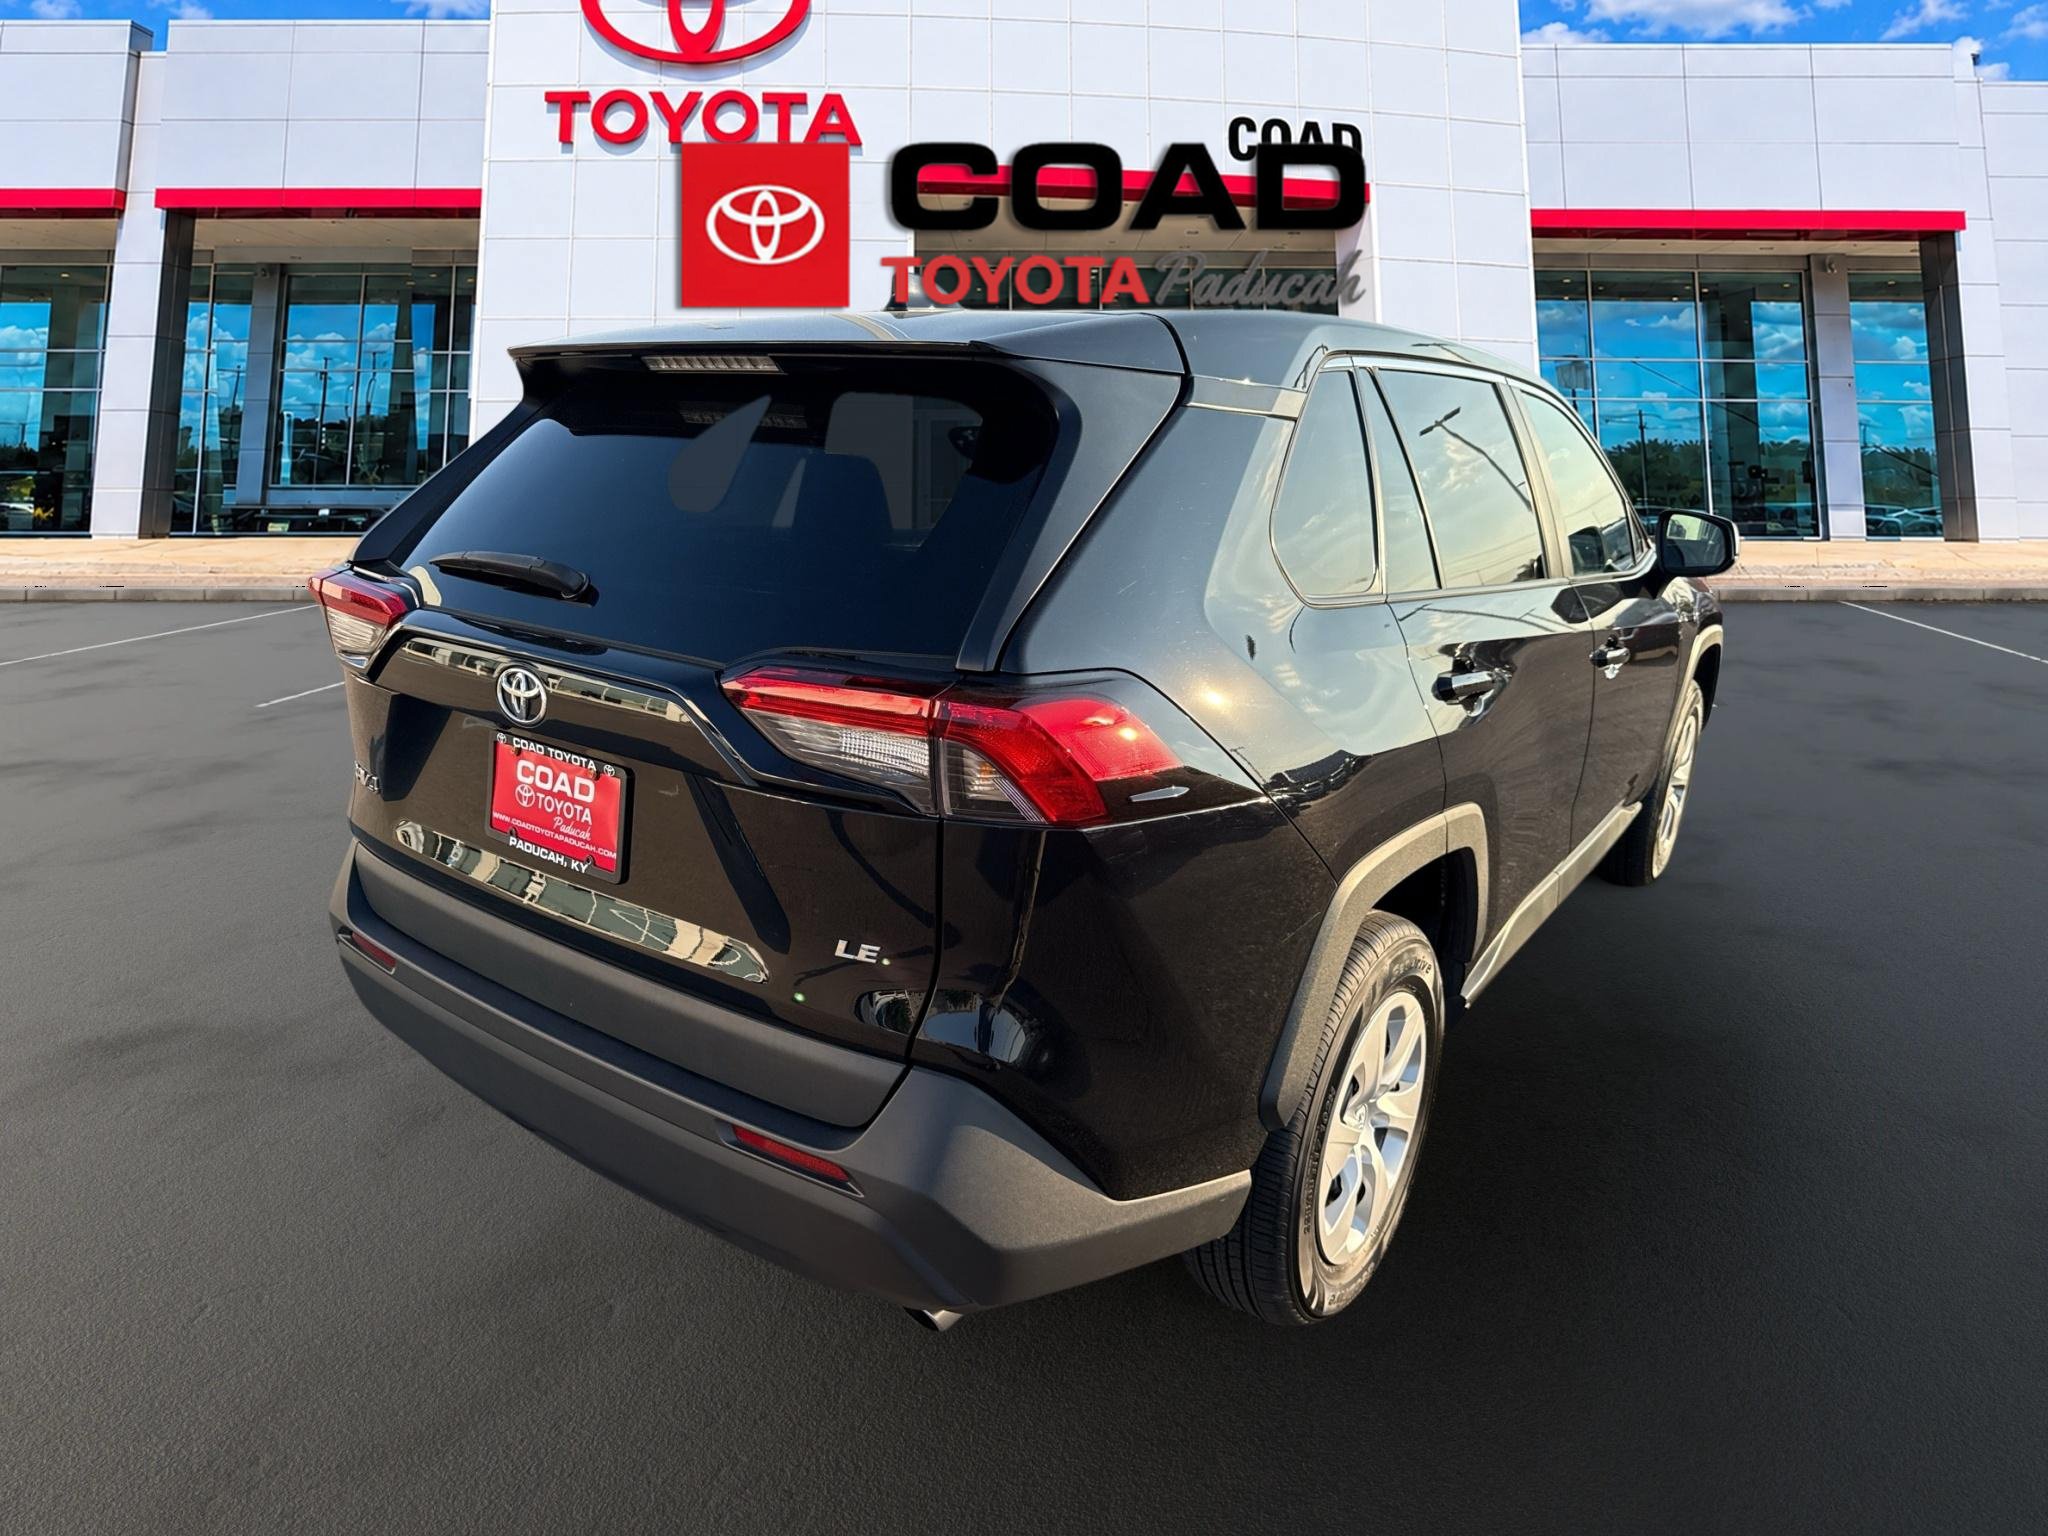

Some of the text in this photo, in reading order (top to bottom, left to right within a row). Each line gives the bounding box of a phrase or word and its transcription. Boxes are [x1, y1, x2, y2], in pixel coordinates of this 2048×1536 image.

[544, 89, 862, 146] TOYOTA
[512, 737, 597, 772] COAD TOYOTA
[516, 759, 595, 803] COAD
[536, 792, 593, 826] TOYOTA
[492, 810, 617, 859] WWW.COADTOYOTAPADUCAH.COM
[552, 816, 592, 841] Paducah
[508, 836, 589, 875] PADUCAH, KY
[835, 939, 881, 963] LE
